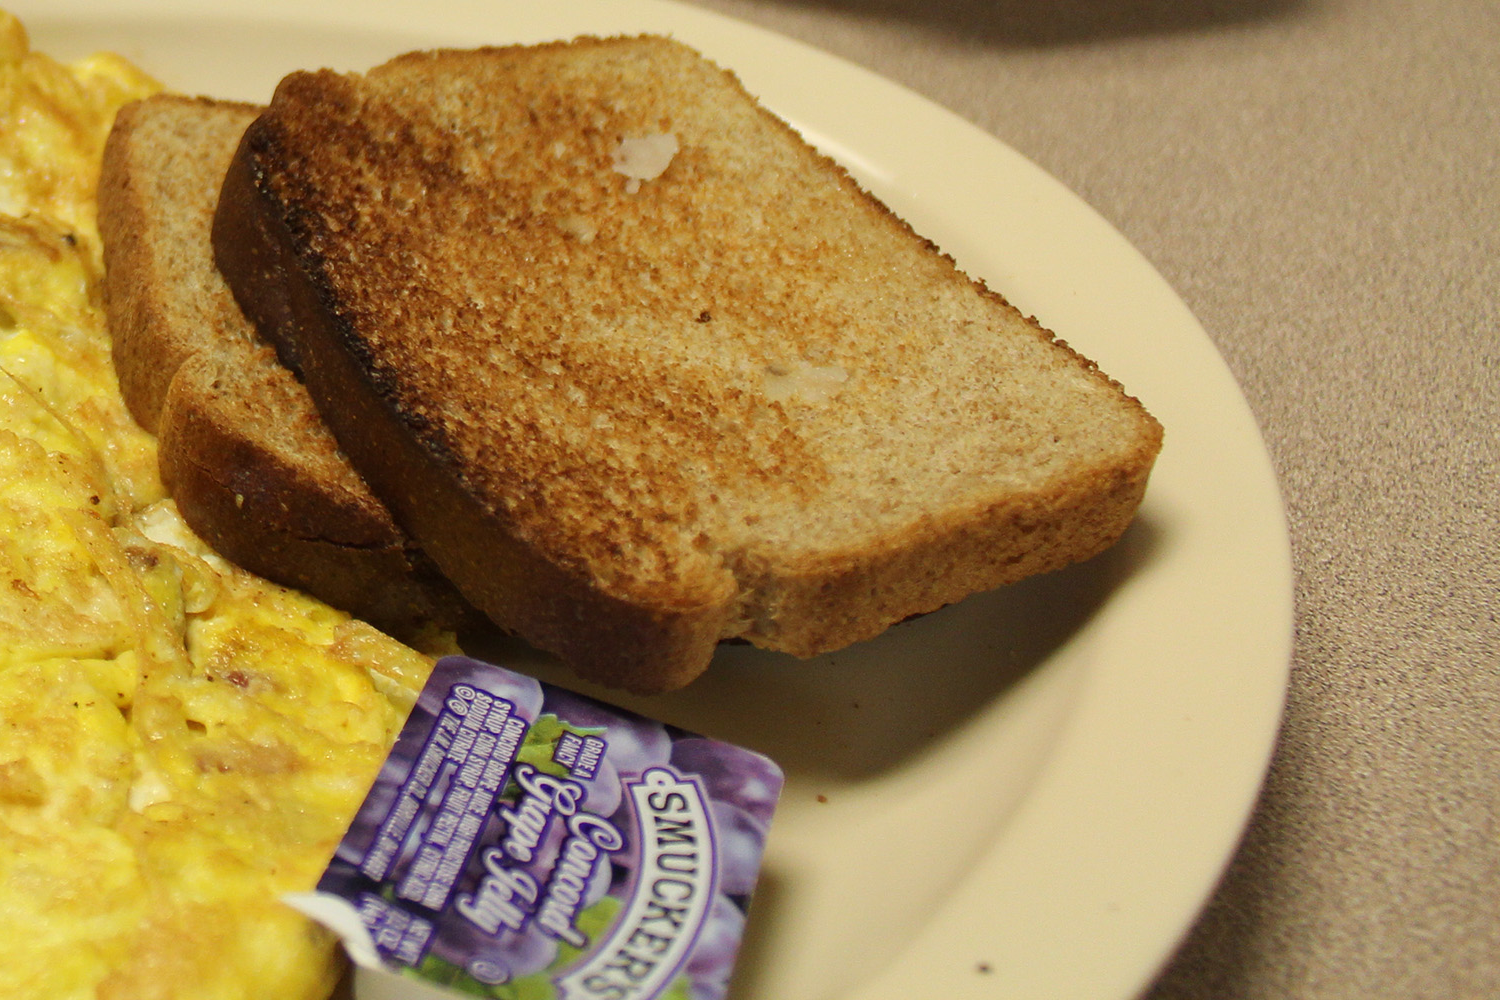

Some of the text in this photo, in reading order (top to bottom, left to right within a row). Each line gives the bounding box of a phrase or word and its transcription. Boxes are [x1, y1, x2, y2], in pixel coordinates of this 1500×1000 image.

[439, 712, 461, 733] THE
[446, 692, 493, 764] SODIUM CITRATE
[481, 698, 511, 735] SYRUP,
[470, 730, 496, 759] CORN
[490, 716, 526, 764] CONCORD
[556, 734, 583, 768] FANCY
[578, 738, 605, 772] GRADE
[455, 753, 486, 791] SYRUP,
[478, 758, 507, 792] GRAPE
[443, 785, 472, 816] FRUIT
[457, 763, 582, 936] Grape Jelly
[539, 814, 623, 947] Concord
[582, 791, 697, 1000] SMUCKER'S
